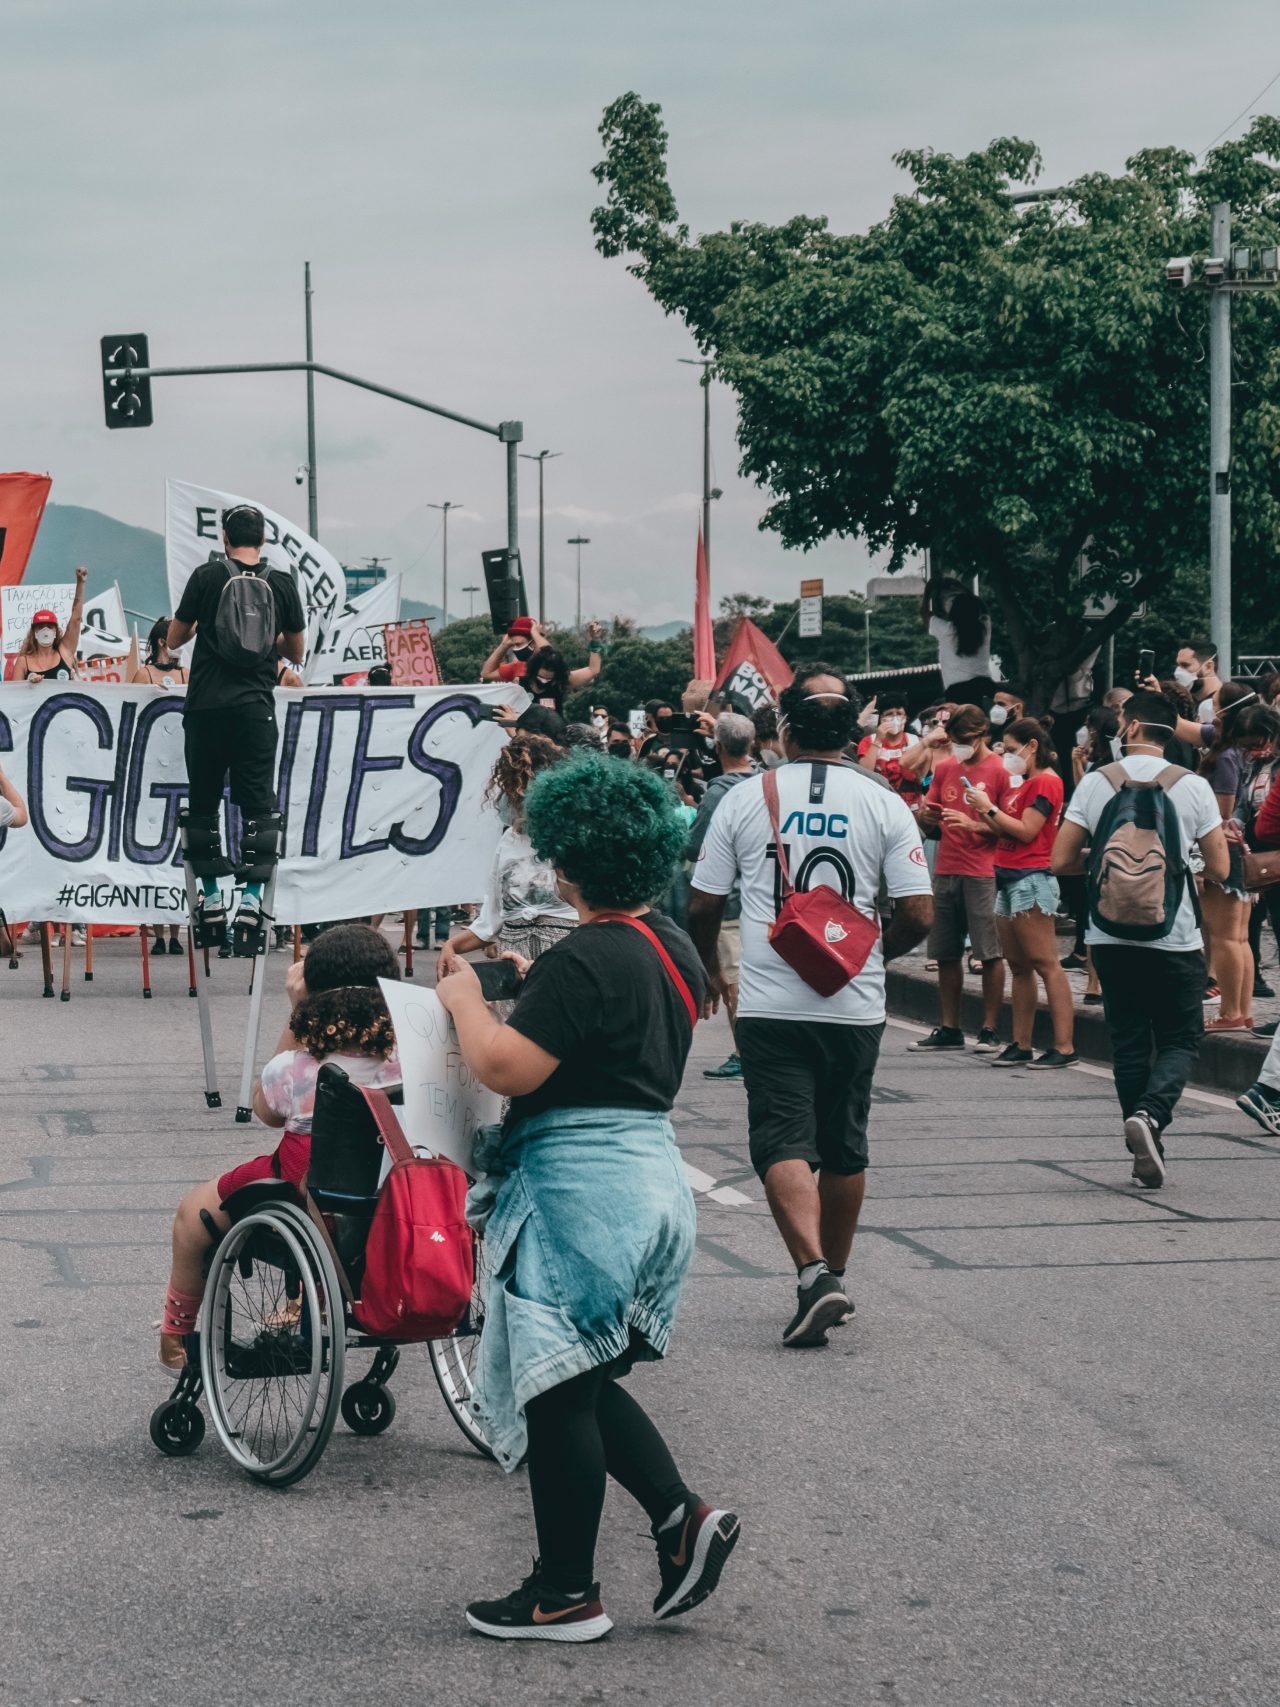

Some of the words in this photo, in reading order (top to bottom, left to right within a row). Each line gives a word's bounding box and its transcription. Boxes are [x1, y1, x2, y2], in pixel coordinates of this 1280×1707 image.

[3, 586, 56, 601] TAXAÇÃO
[61, 588, 75, 600] DE
[342, 645, 383, 662] AER
[392, 656, 434, 678] SICO
[26, 692, 482, 867] GIGTES
[780, 811, 849, 839] AOC
[420, 1082, 458, 1130] TEM
